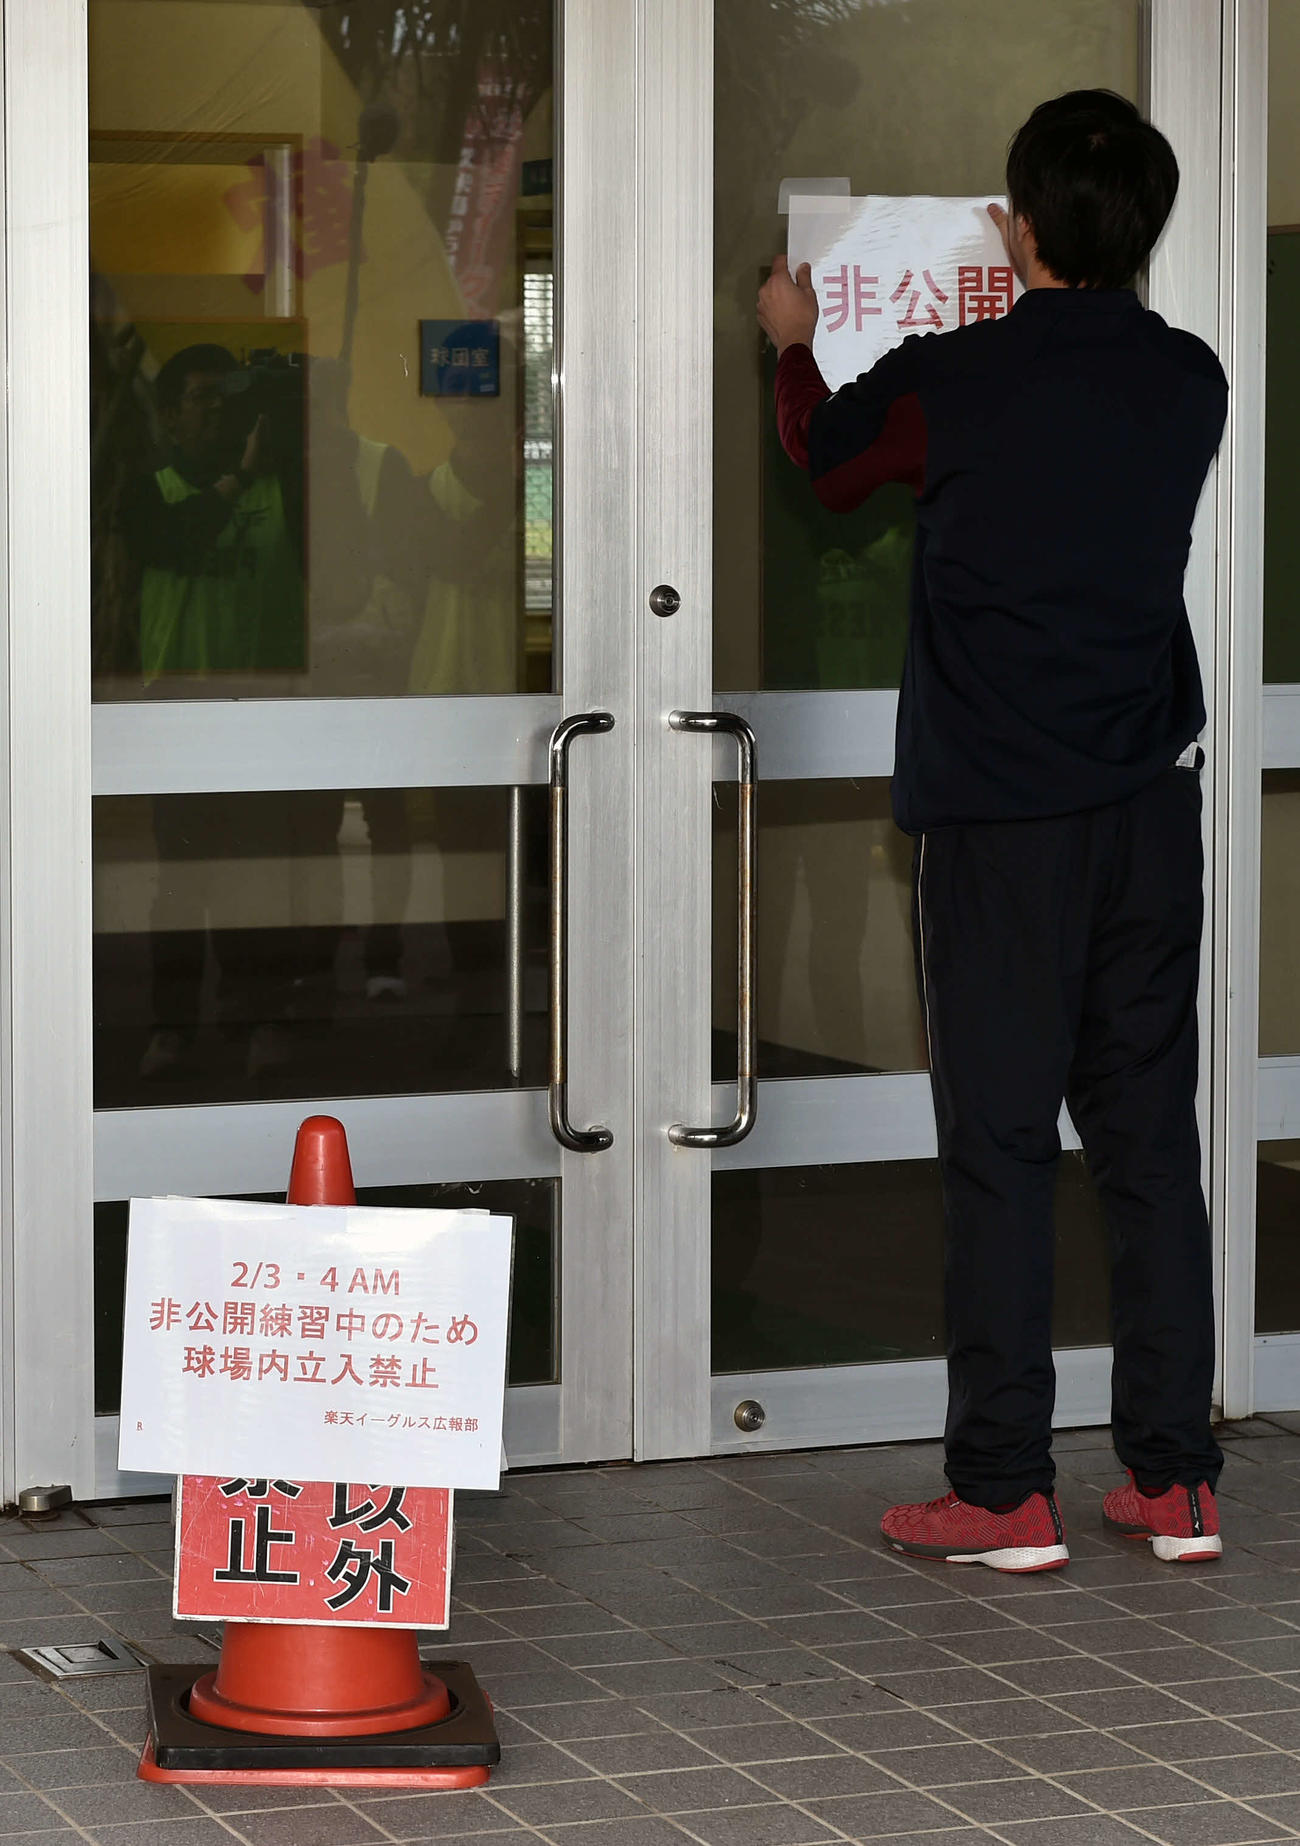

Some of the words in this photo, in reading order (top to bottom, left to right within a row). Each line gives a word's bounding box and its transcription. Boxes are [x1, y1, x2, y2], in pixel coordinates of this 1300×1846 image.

[822, 264, 1014, 333] 非公開
[348, 1267, 400, 1296] AM
[149, 1297, 478, 1345] 非公開練習中のため
[182, 1345, 439, 1389] 球場内立入禁止
[324, 1410, 479, 1432] 楽天イーグルス広報部
